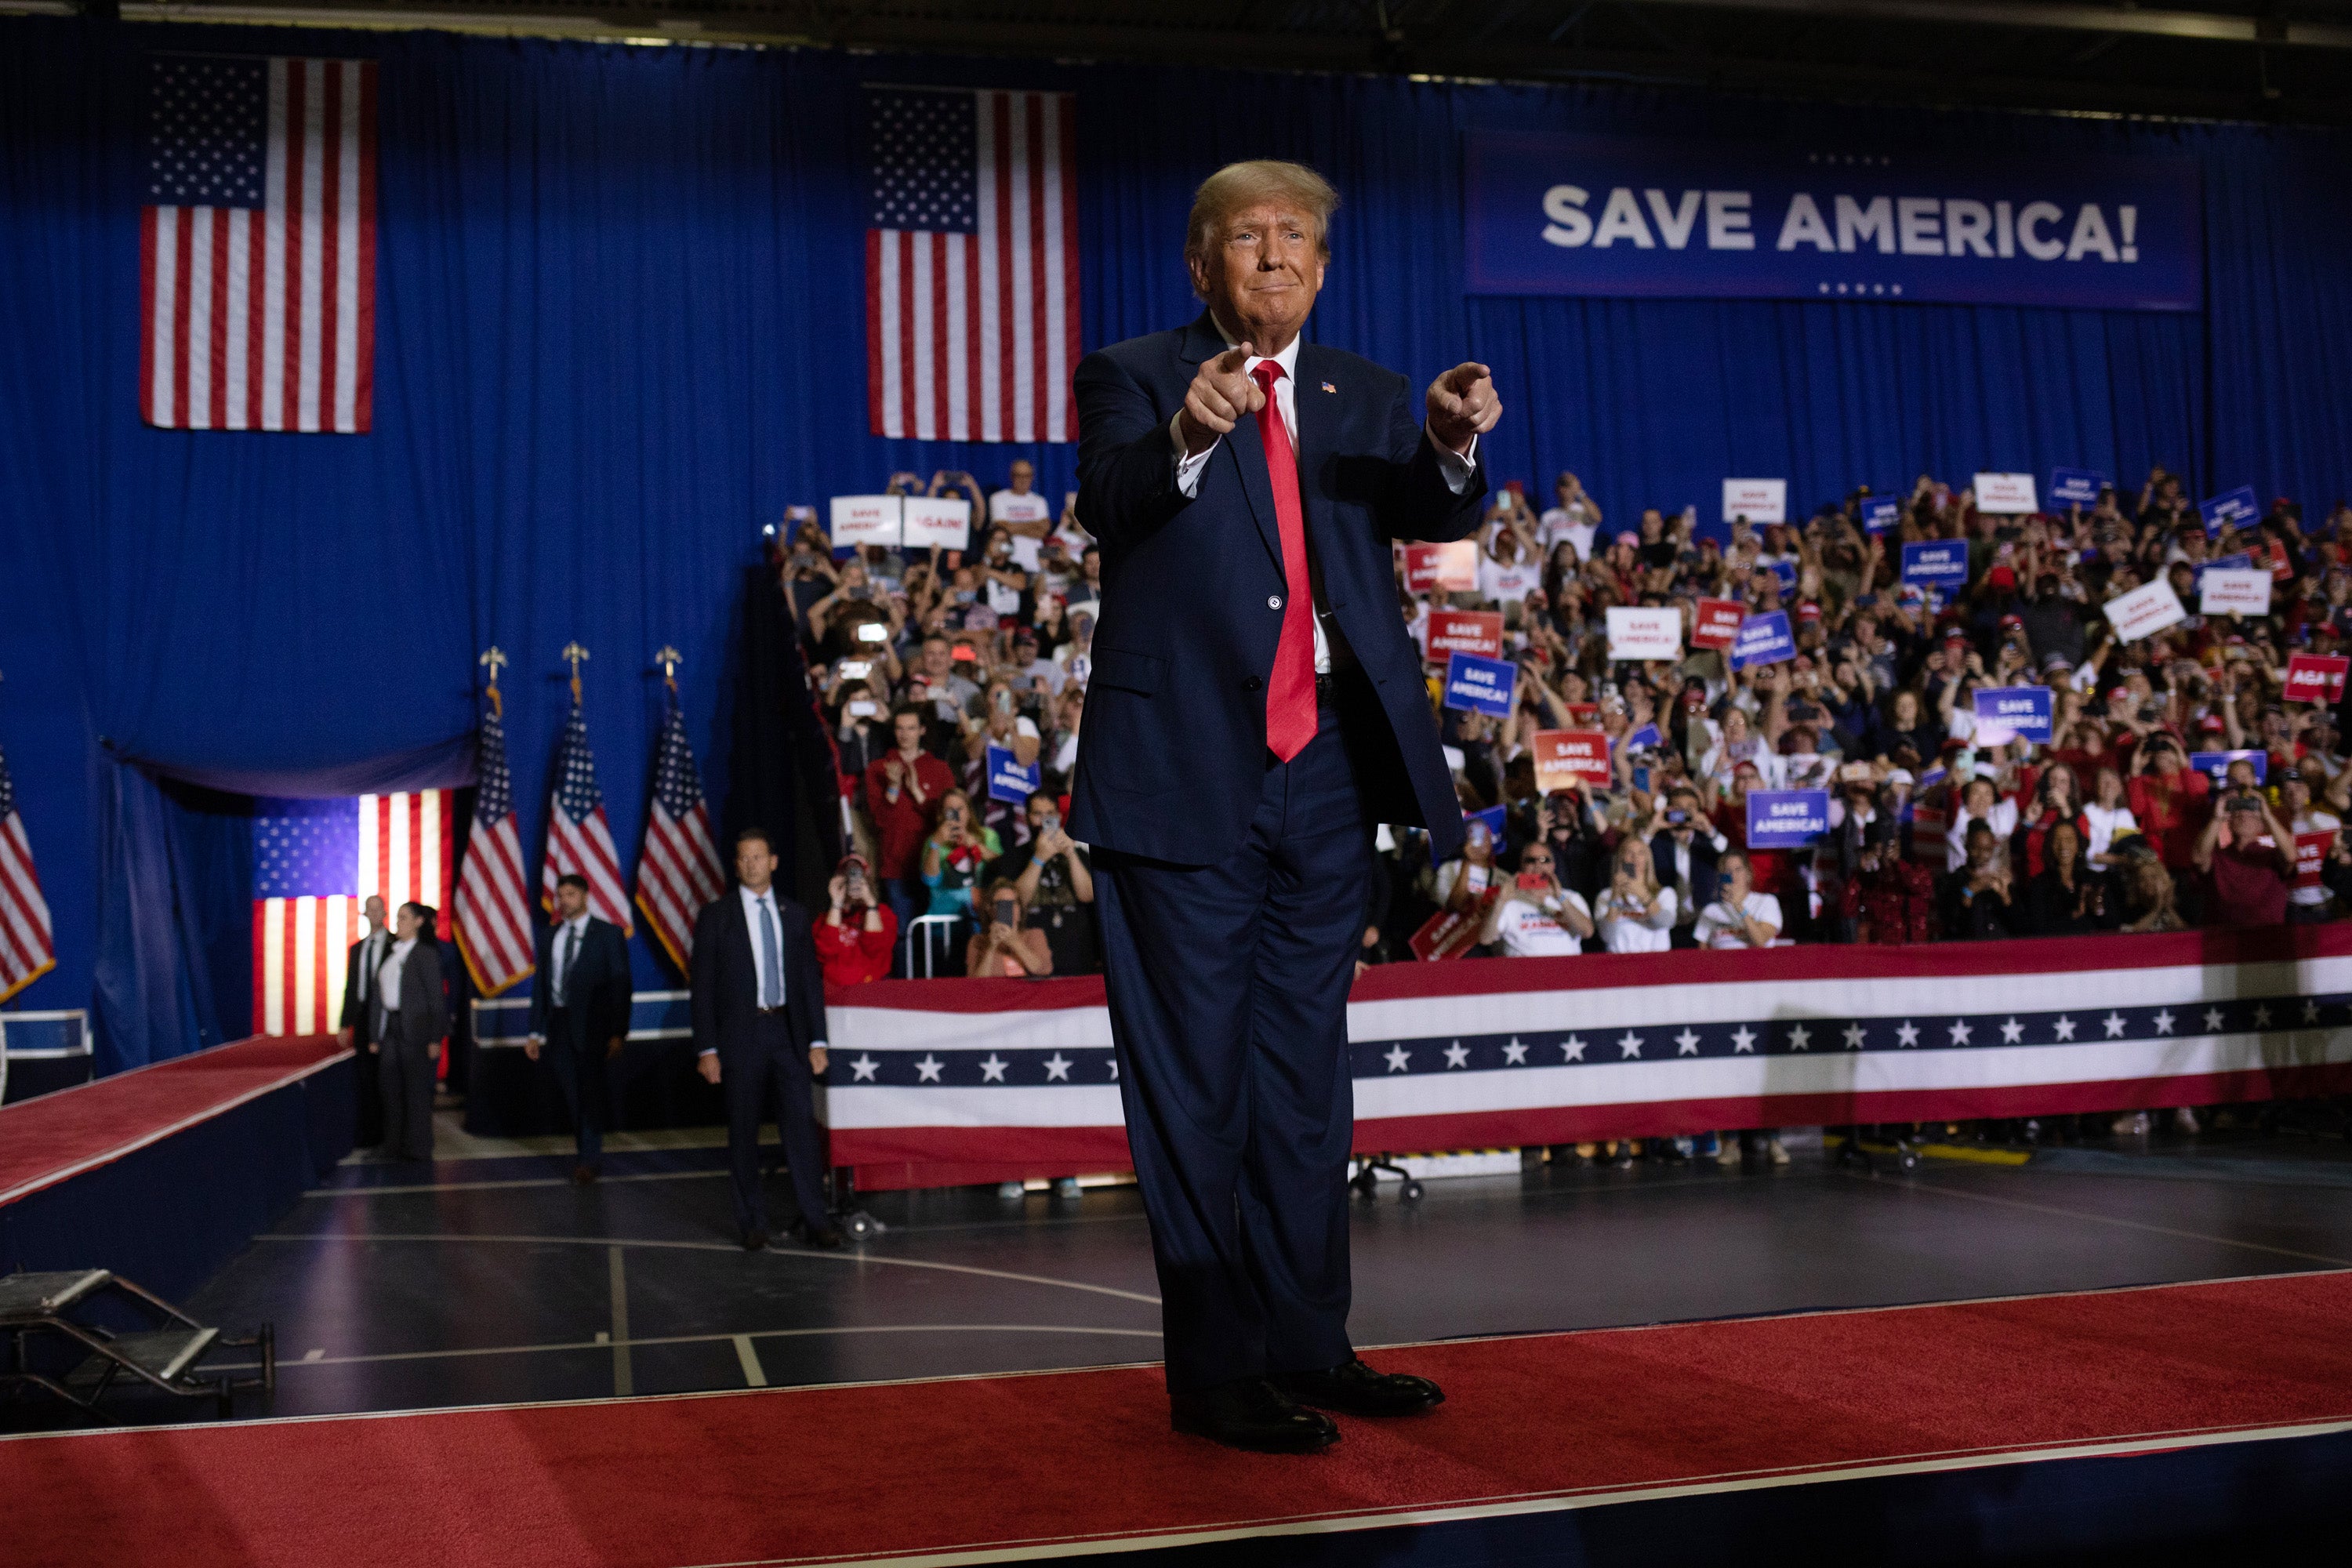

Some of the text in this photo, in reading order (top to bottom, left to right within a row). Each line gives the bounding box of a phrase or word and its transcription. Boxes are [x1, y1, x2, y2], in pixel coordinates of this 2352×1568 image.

[1541, 185, 2138, 263] SAVE AMERICA!
[1446, 622, 1482, 636] SAVE
[1630, 622, 1660, 630] SAVE
[1432, 637, 1496, 652] AMERICA!
[1465, 667, 1496, 685] SAVE
[1451, 681, 1508, 703] AMERICA!
[1998, 699, 2034, 713] SAVE
[1556, 742, 1592, 756] SAVE
[1543, 758, 1606, 773] AMERICA!
[1770, 802, 1808, 816] SAVE
[1755, 818, 1825, 833] AMERICA!
